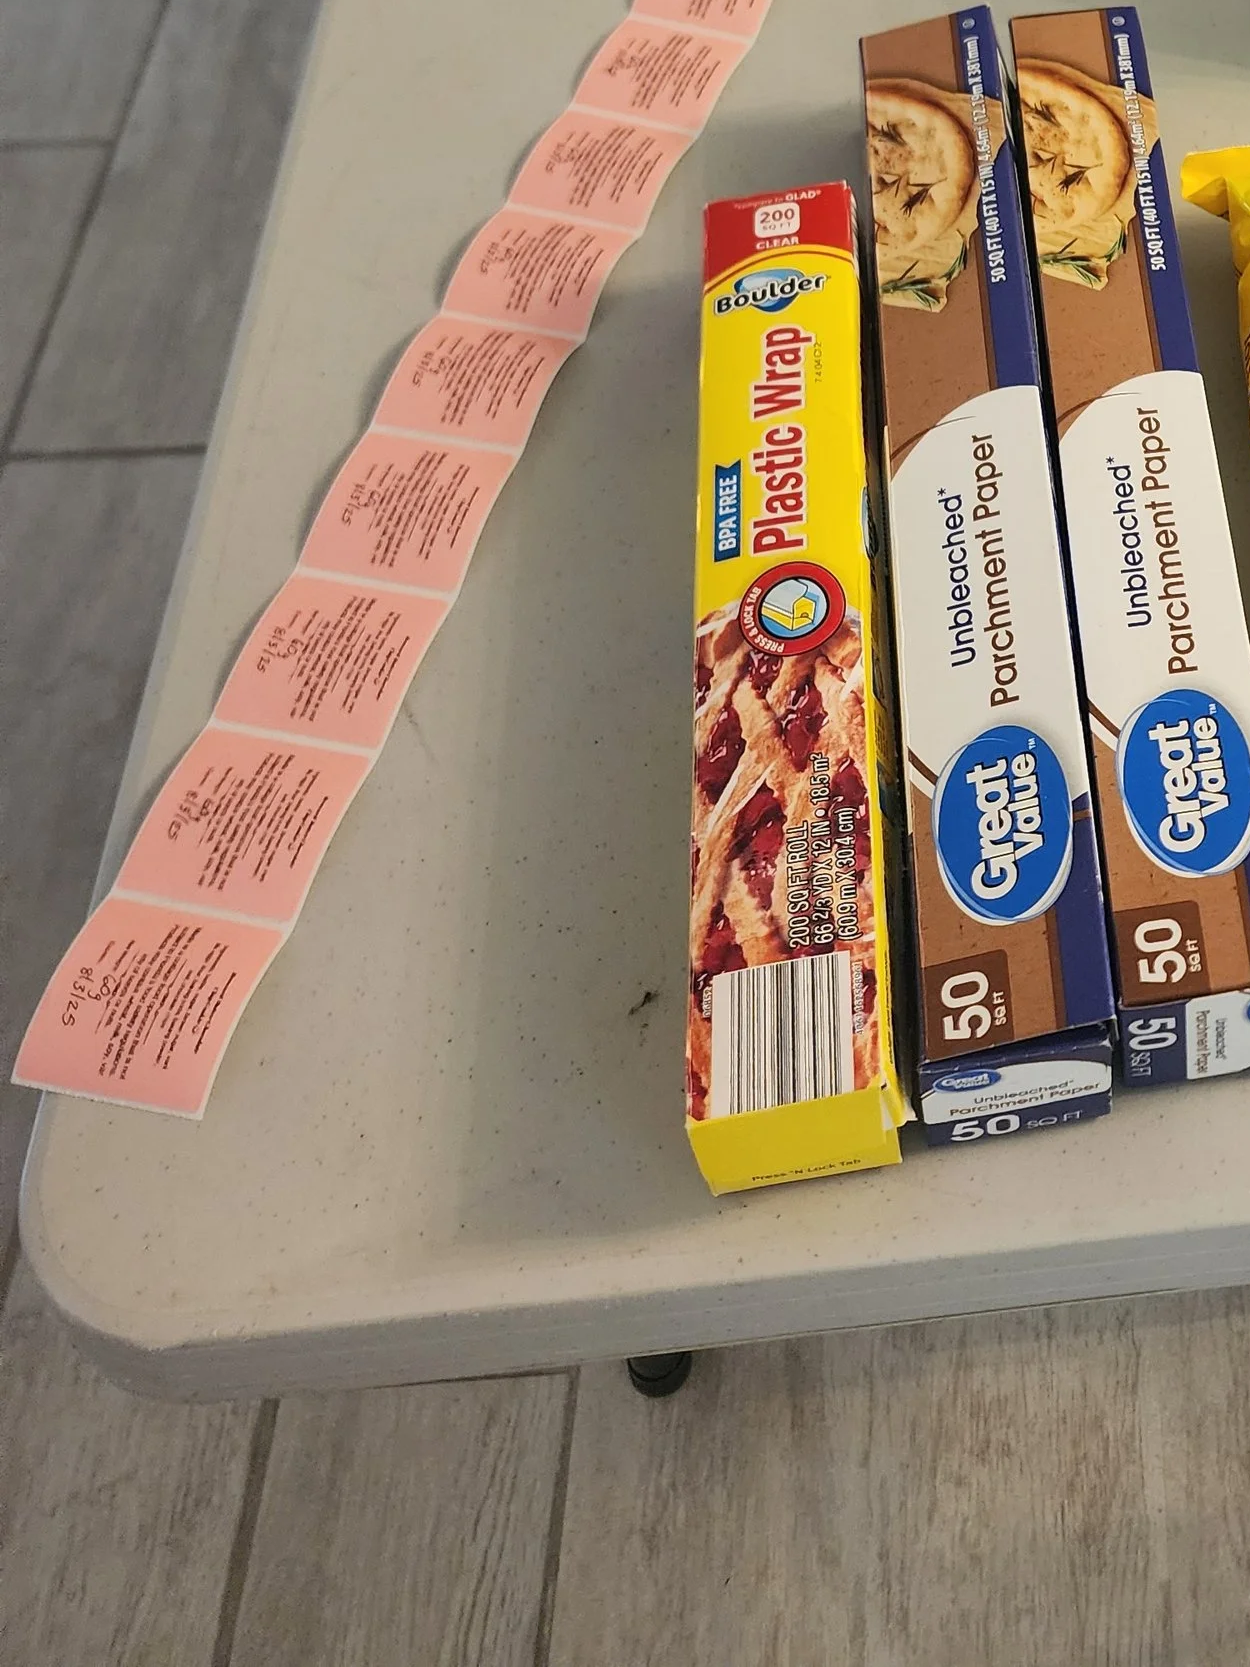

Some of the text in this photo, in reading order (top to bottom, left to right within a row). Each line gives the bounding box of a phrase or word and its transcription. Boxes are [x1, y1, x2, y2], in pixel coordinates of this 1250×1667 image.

[963, 36, 980, 56] mm)
[1114, 33, 1130, 53] mm)
[967, 56, 982, 75] 381
[1118, 52, 1133, 70] 381
[977, 138, 992, 162] 4.64
[1132, 131, 1147, 155] 4.64
[978, 160, 995, 178] IN)
[1135, 154, 1151, 171] IN)
[759, 208, 795, 224] 200
[780, 221, 792, 229] FT
[984, 216, 1003, 233] (40
[1143, 207, 1160, 224] (40
[756, 236, 799, 250] CLEAR
[987, 233, 1002, 249] FT
[1145, 224, 1160, 239] FT
[990, 249, 1006, 267] SQ
[1148, 240, 1164, 256] SQ
[991, 266, 1007, 283] 50
[1151, 255, 1167, 271] 50
[714, 274, 826, 315] Boulder
[752, 326, 813, 555] Plastic Wrap
[717, 475, 737, 552] BPA FREE
[1136, 407, 1198, 675] Parchment Paper
[971, 434, 1020, 708] Parchment Paper
[747, 585, 762, 603] TAB
[743, 601, 755, 628] LOCK
[754, 633, 784, 653] PRESS
[1191, 715, 1230, 818] Value
[810, 775, 830, 806] 18.5
[1148, 718, 1205, 854] Great
[1006, 751, 1044, 861] Value
[835, 807, 856, 834] cm)
[965, 755, 1018, 901] Great
[811, 824, 830, 842] IN
[811, 844, 830, 864] 12
[786, 820, 811, 949] 200 SQ FT ROLL
[812, 876, 832, 898] YD
[812, 898, 833, 922] 2/3
[813, 922, 834, 946] 66
[1134, 917, 1188, 983] 50
[1186, 938, 1202, 972] SQ FT
[61, 966, 94, 1027] 8/3/25
[87, 974, 117, 1001] 60g
[940, 970, 993, 1040] 50
[993, 991, 1008, 1025] SQ FT
[1128, 1016, 1178, 1051] 50
[949, 1082, 1101, 1116] Parchment Paper
[951, 1110, 1082, 1142] 50 SQ FT
[752, 1169, 788, 1183] Press
[807, 1162, 836, 1173] Lock
[838, 1157, 862, 1168] Tab
